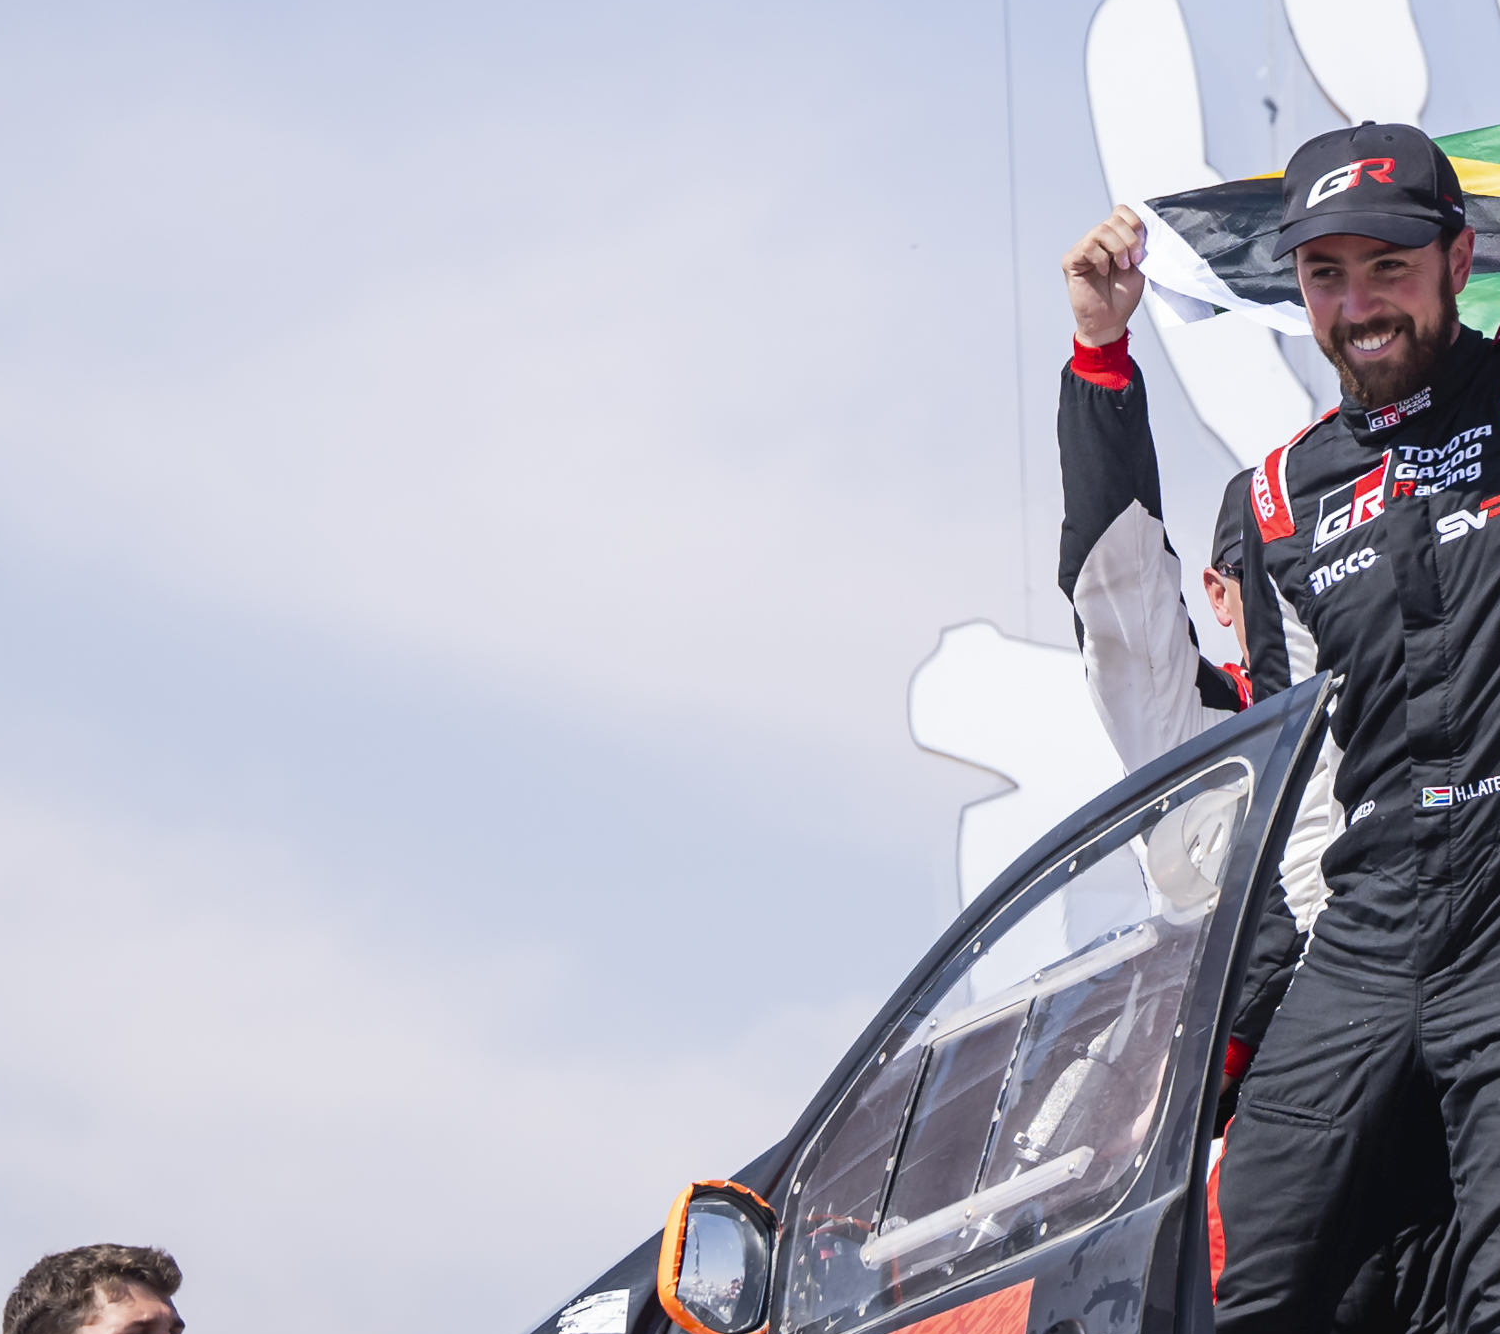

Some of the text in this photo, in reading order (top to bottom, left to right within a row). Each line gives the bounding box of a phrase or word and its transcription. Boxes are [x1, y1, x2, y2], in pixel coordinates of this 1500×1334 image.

[1306, 157, 1396, 209] GR
[1371, 409, 1398, 430] GR
[1395, 443, 1482, 479] GAZOO
[1399, 424, 1492, 462] TOYOTA
[1392, 462, 1482, 497] Racing
[1315, 486, 1385, 544] GR
